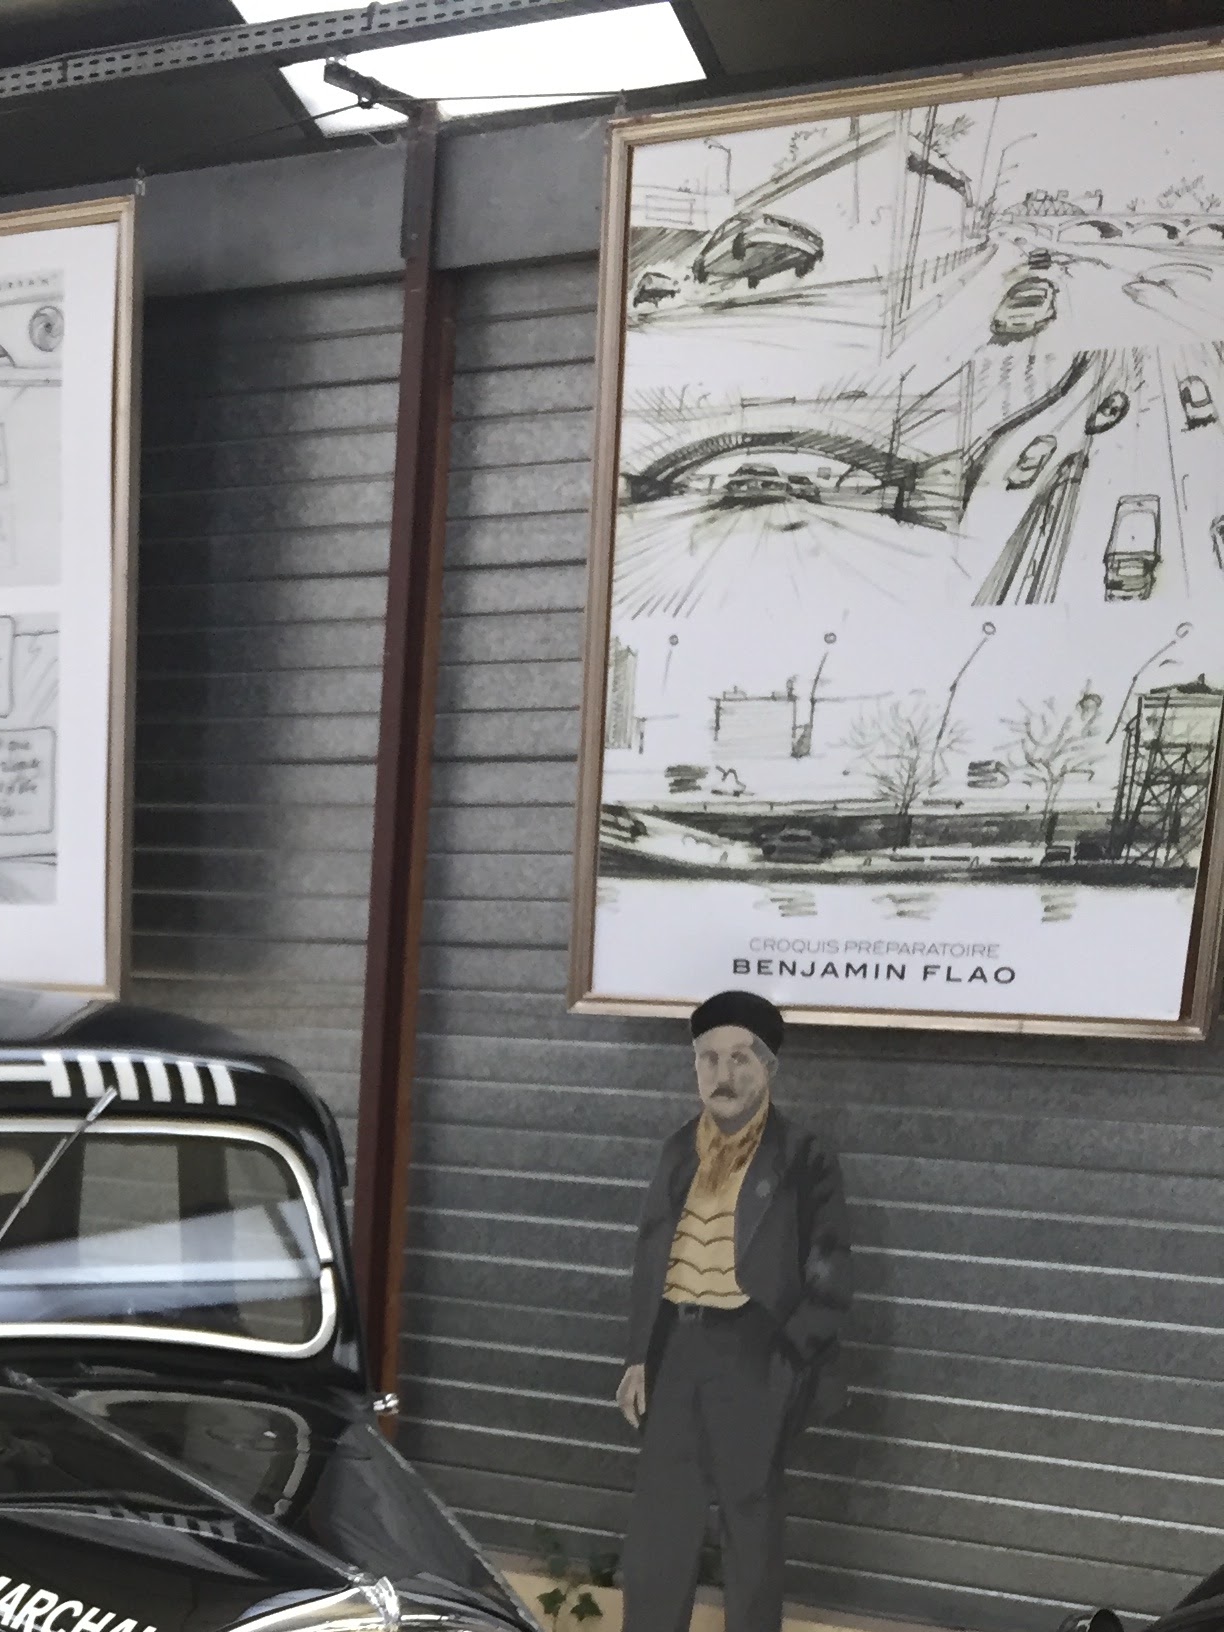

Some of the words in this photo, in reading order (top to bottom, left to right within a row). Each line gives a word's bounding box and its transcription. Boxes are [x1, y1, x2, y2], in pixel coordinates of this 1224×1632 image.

[749, 936, 840, 955] CROQUIS
[732, 957, 907, 981] BENJAMIN
[922, 964, 1017, 985] FLAO
